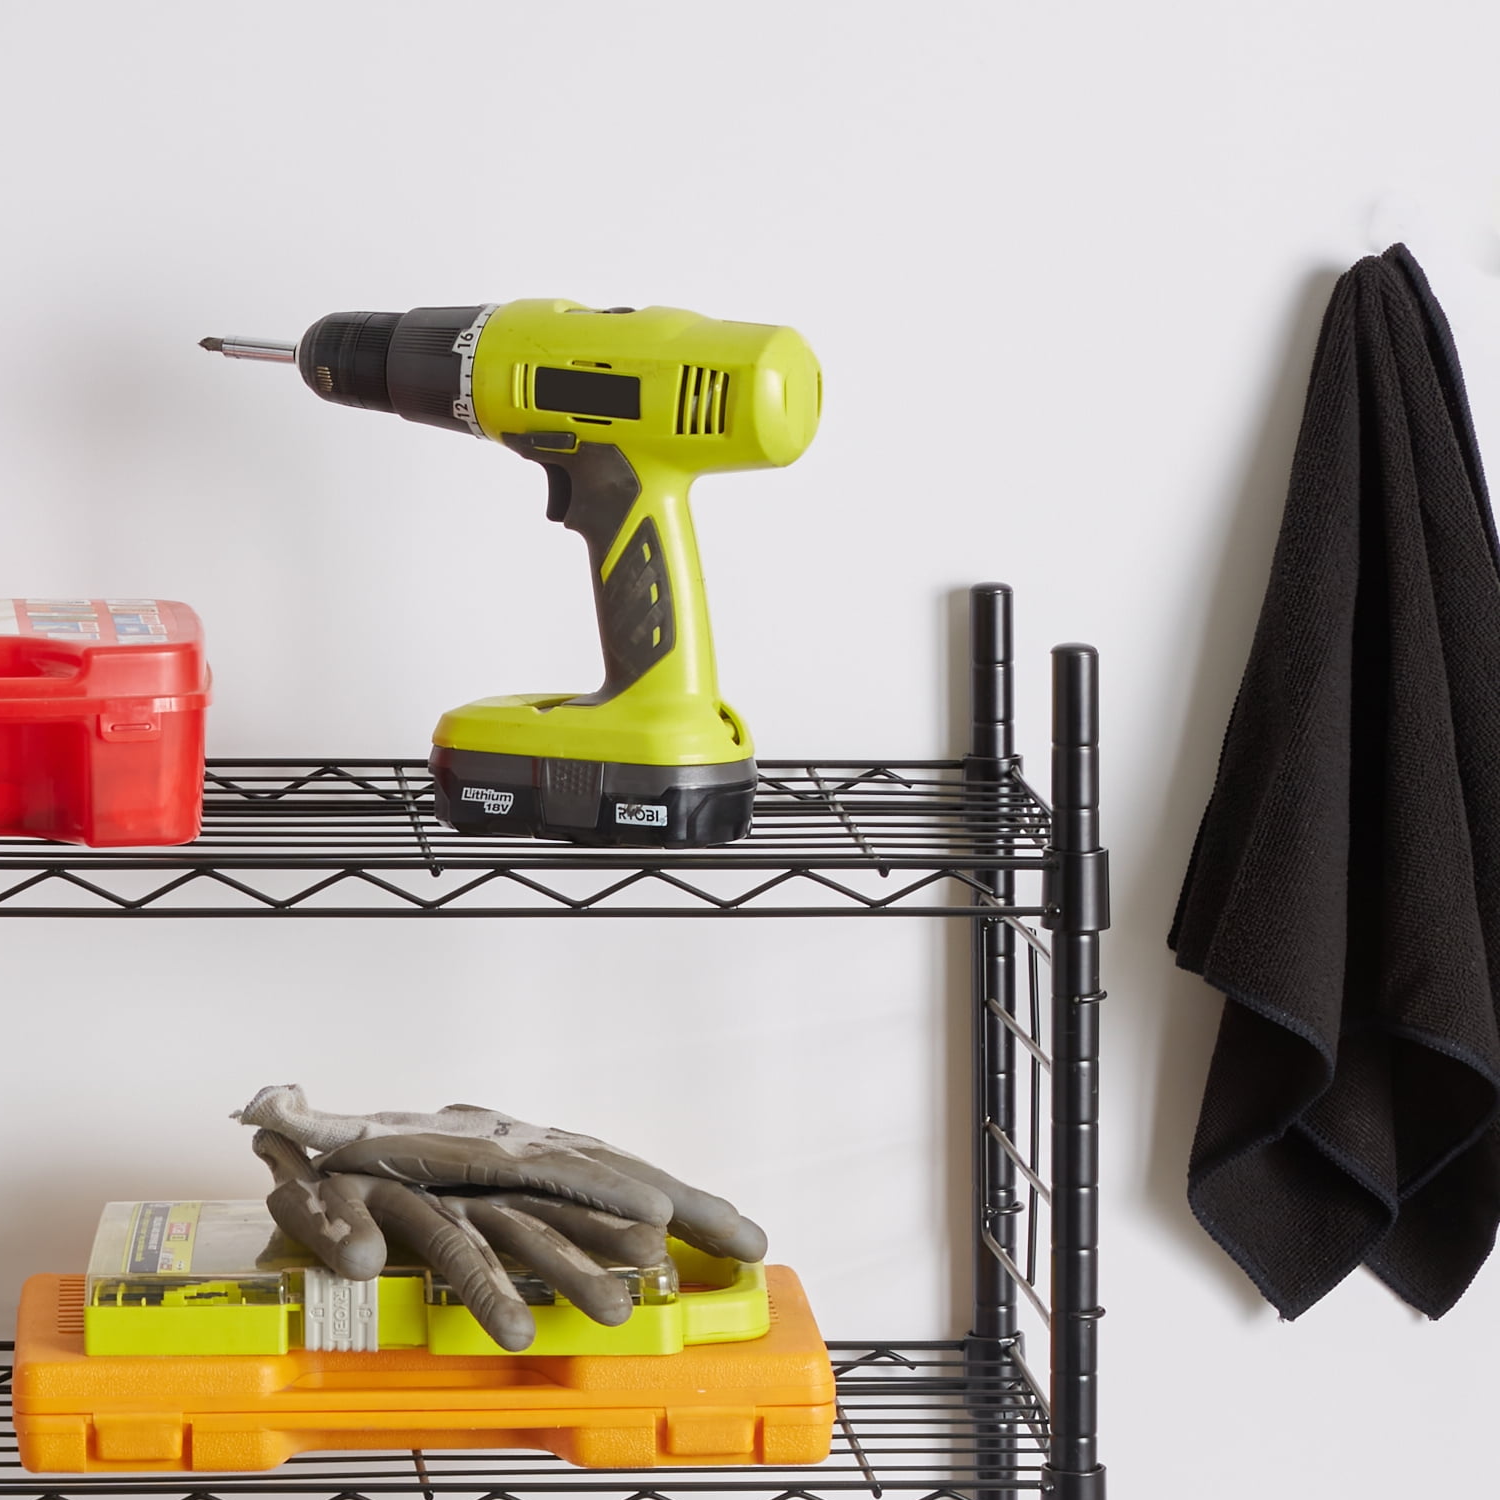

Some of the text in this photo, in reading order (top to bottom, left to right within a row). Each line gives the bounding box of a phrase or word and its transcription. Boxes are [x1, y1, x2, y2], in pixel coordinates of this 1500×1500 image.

[457, 332, 474, 349] 16
[455, 402, 470, 418] 12
[462, 788, 512, 802] Lithium
[486, 803, 510, 813] 18V
